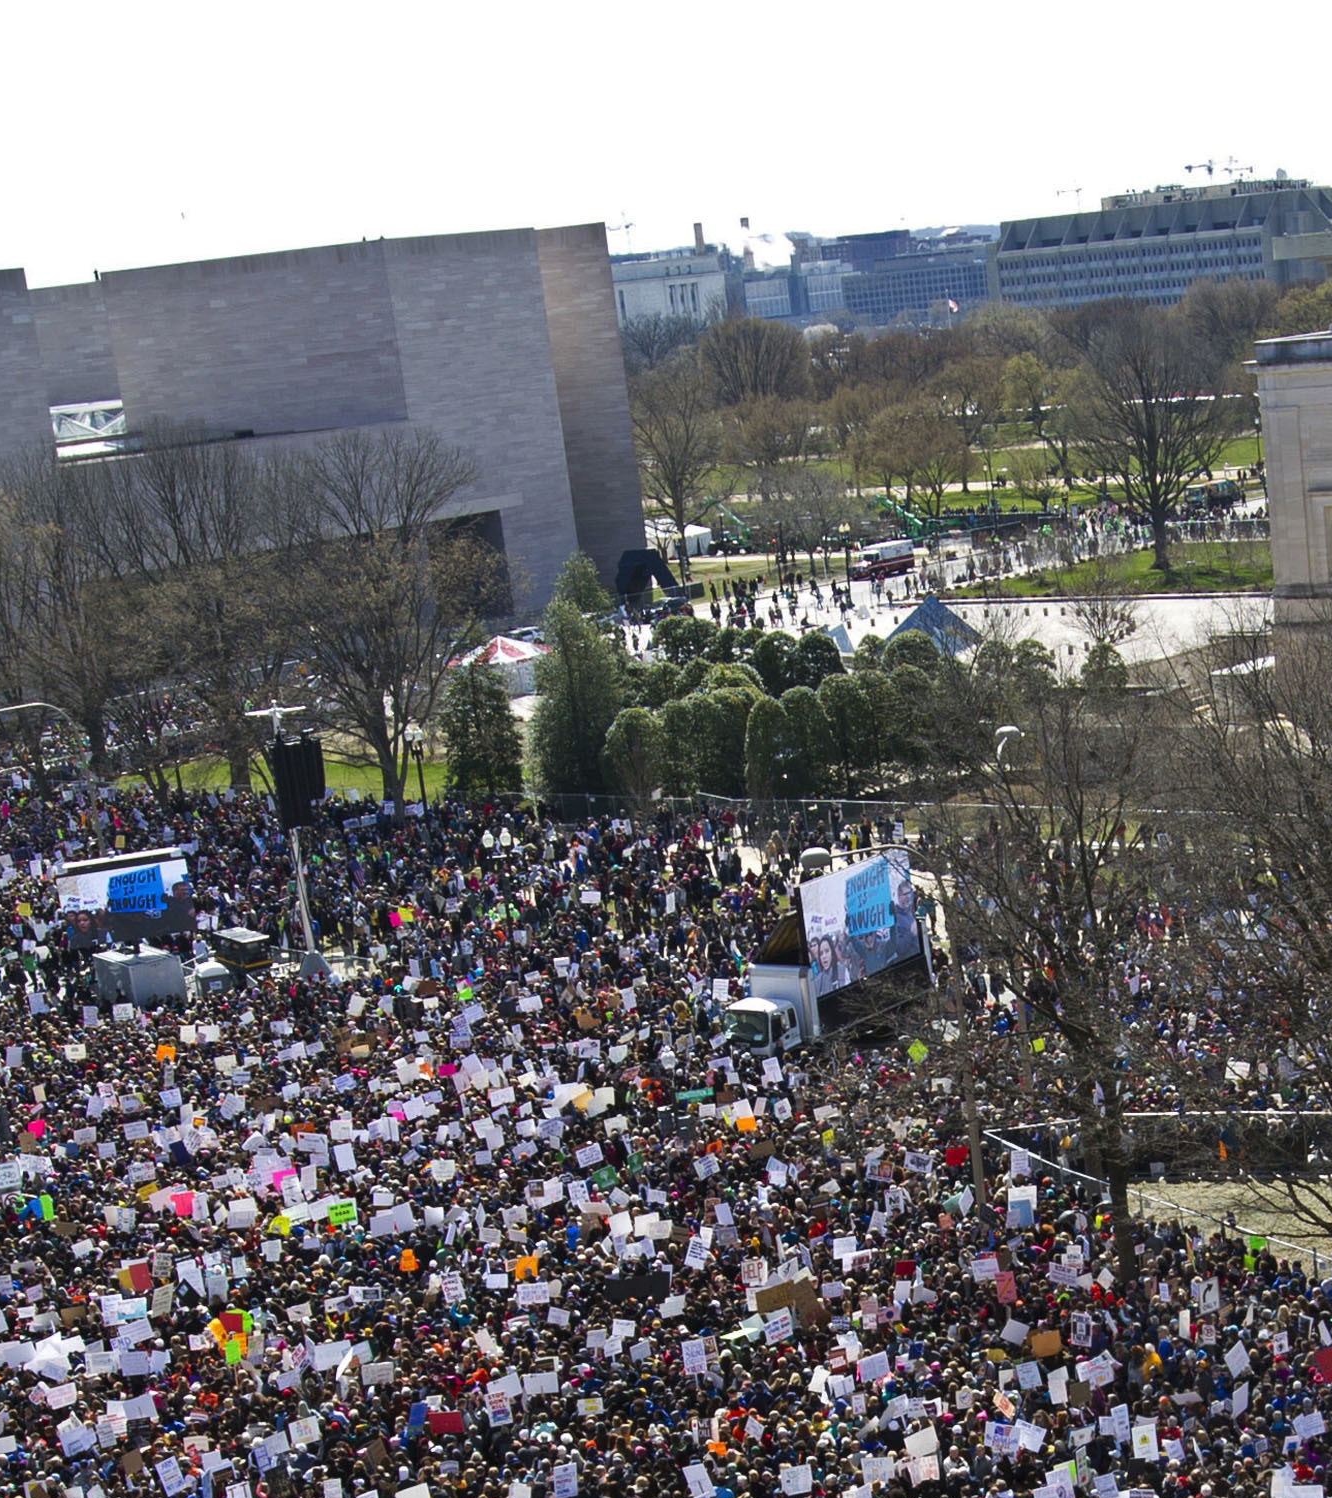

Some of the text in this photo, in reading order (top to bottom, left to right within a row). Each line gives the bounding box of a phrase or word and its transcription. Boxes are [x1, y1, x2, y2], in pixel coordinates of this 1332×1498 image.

[109, 868, 157, 890] ENOUGH
[846, 865, 885, 893] ENOUGH
[123, 885, 135, 896] IS
[857, 893, 868, 906] IS
